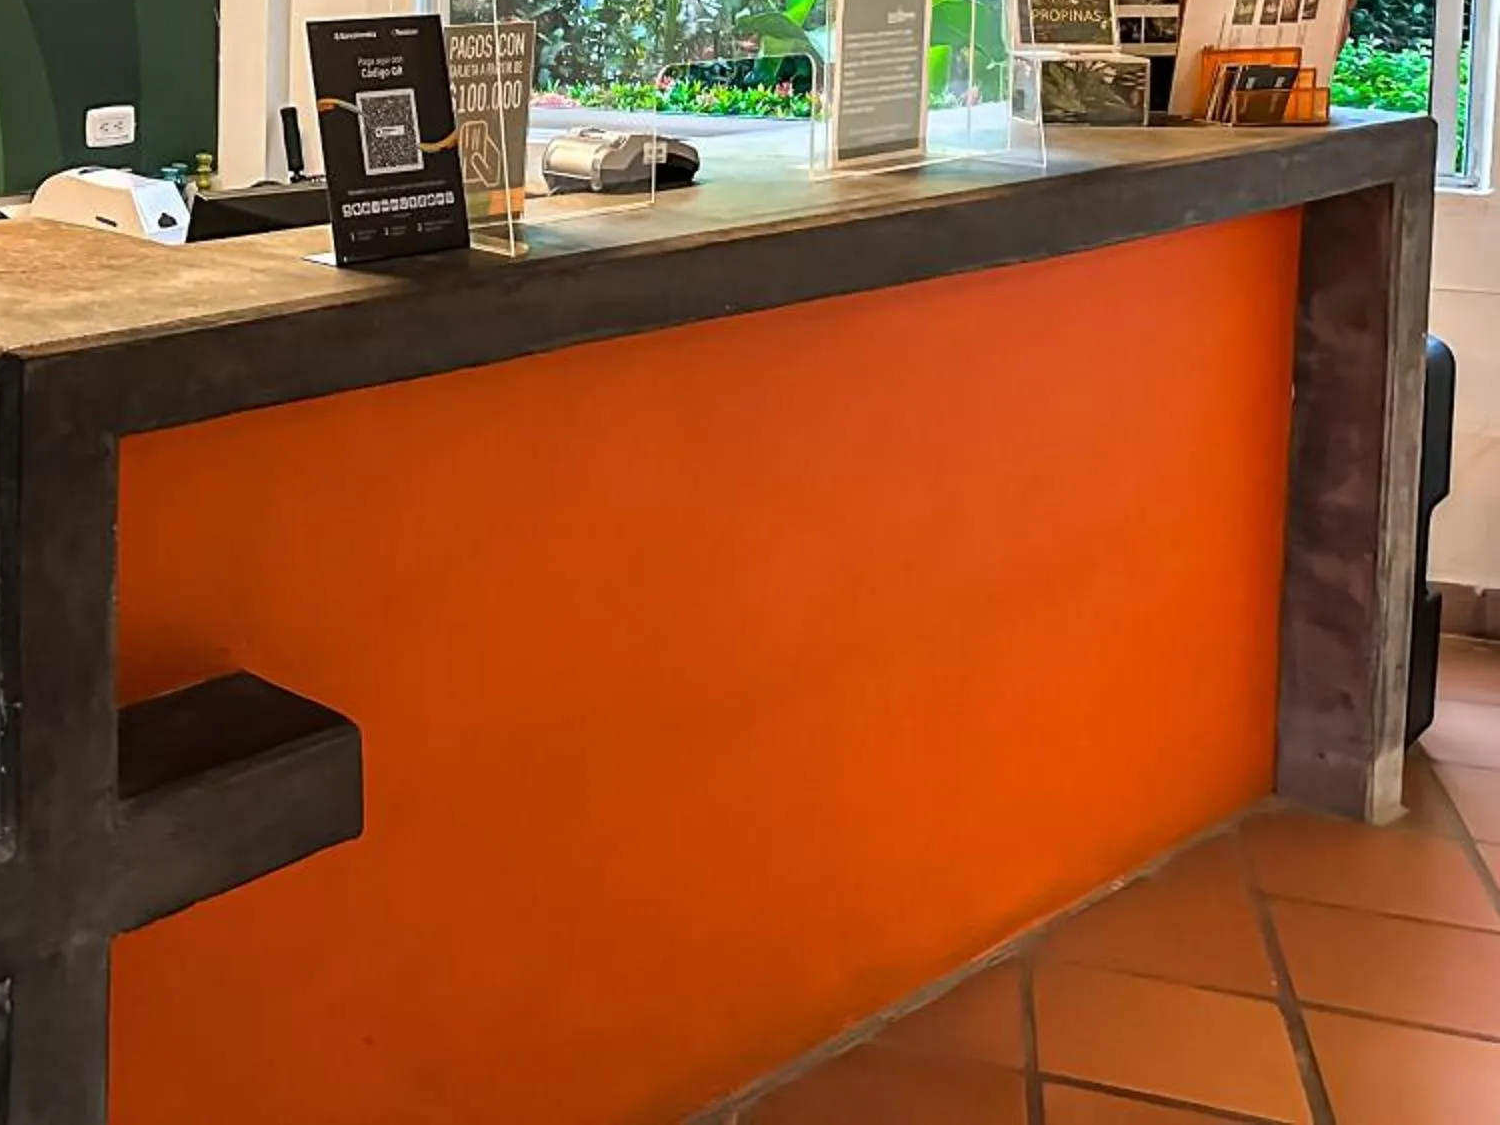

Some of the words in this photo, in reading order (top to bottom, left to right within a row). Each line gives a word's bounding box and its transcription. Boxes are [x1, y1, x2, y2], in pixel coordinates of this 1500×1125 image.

[1031, 7, 1101, 23] PROPINAS
[450, 34, 493, 59] PAGOS
[498, 31, 525, 56] CON
[449, 62, 479, 78] ARJETA
